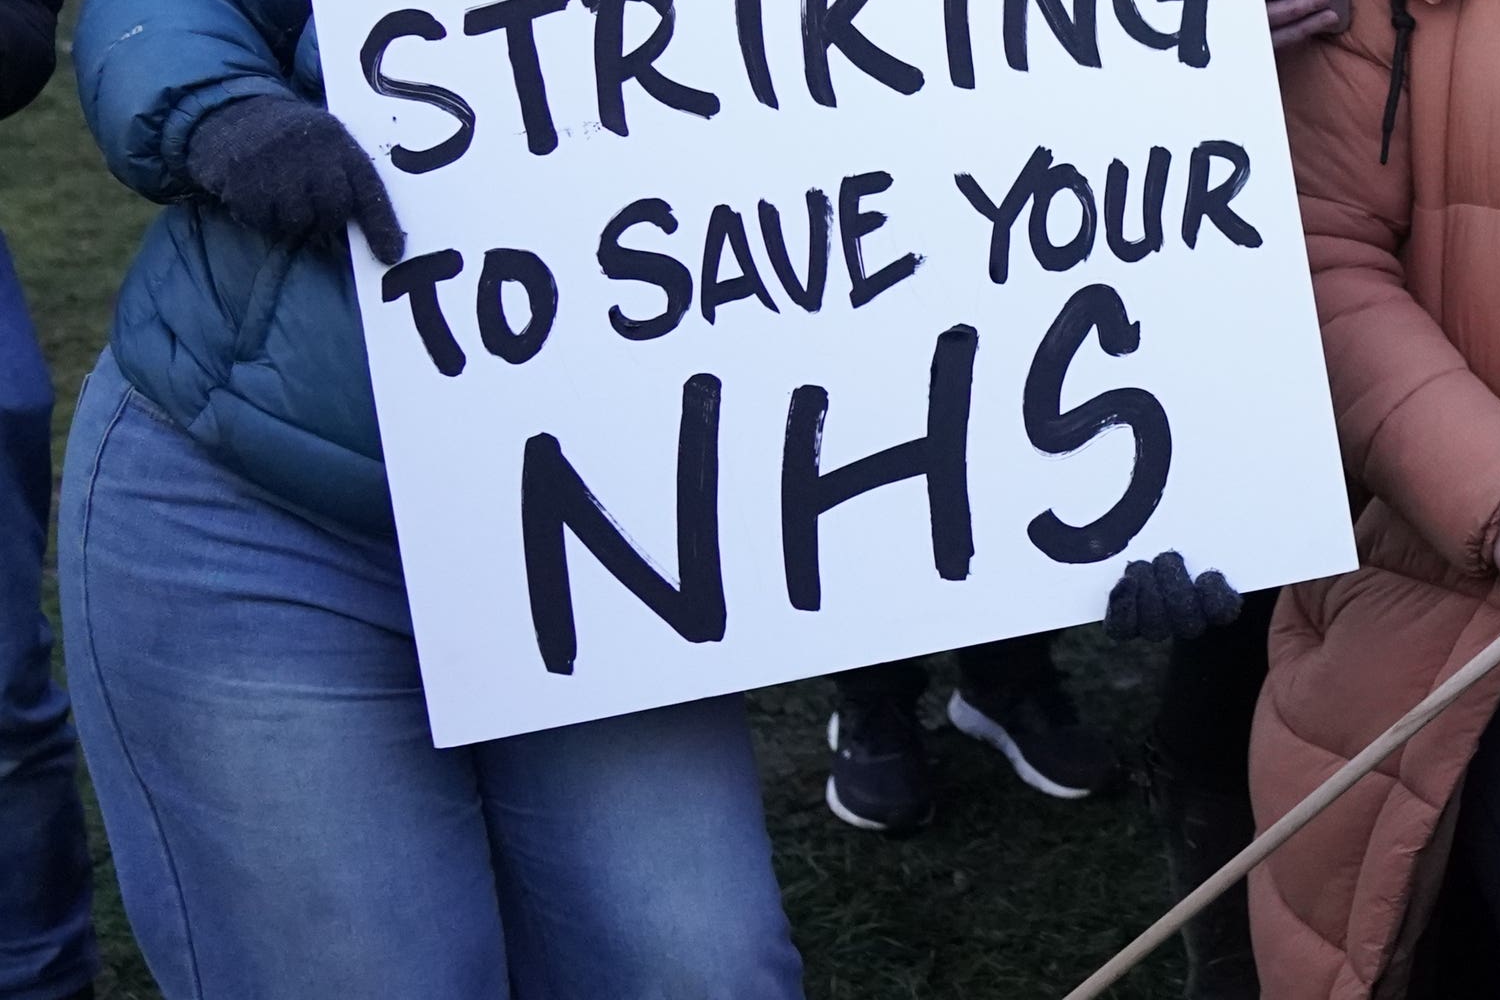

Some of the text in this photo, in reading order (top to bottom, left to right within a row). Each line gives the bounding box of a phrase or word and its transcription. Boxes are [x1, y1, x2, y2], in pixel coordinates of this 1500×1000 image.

[381, 139, 1263, 377] TO SAVE YOUR
[520, 282, 1174, 676] NHS
